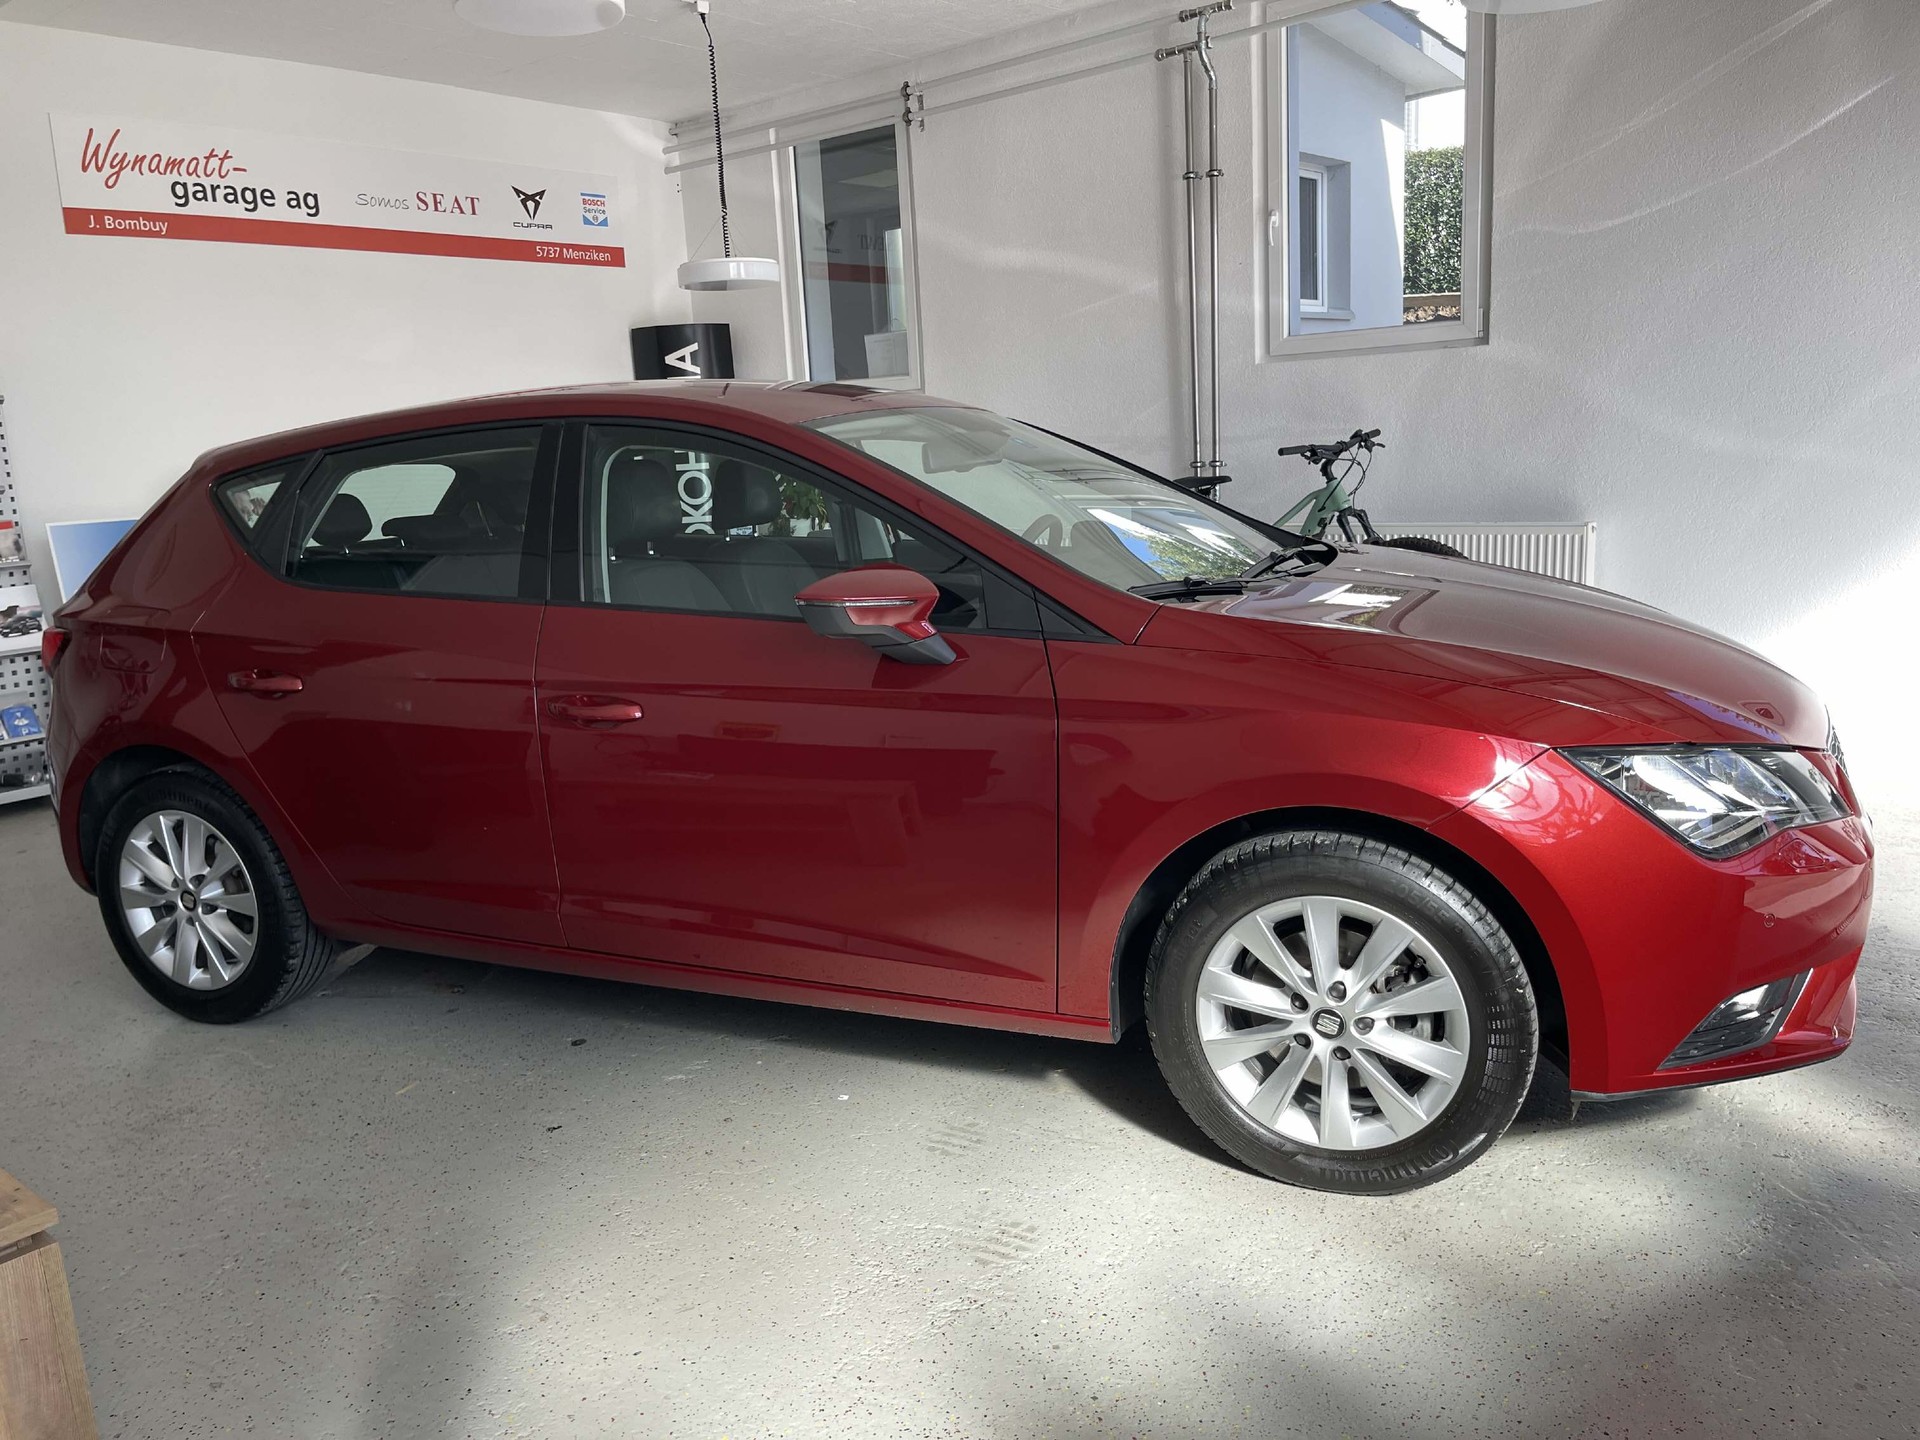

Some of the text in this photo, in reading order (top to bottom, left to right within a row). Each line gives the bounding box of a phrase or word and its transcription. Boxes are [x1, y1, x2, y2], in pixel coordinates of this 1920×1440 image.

[81, 128, 248, 189] Wynamatt-
[171, 180, 320, 217] garage ag
[355, 191, 480, 216] Somos SEAT
[582, 198, 605, 207] BOSCH
[583, 206, 606, 215] Service
[88, 215, 168, 234] J. Bombuy
[513, 222, 553, 230] CUPRA
[536, 245, 611, 262] 5737 Menziken
